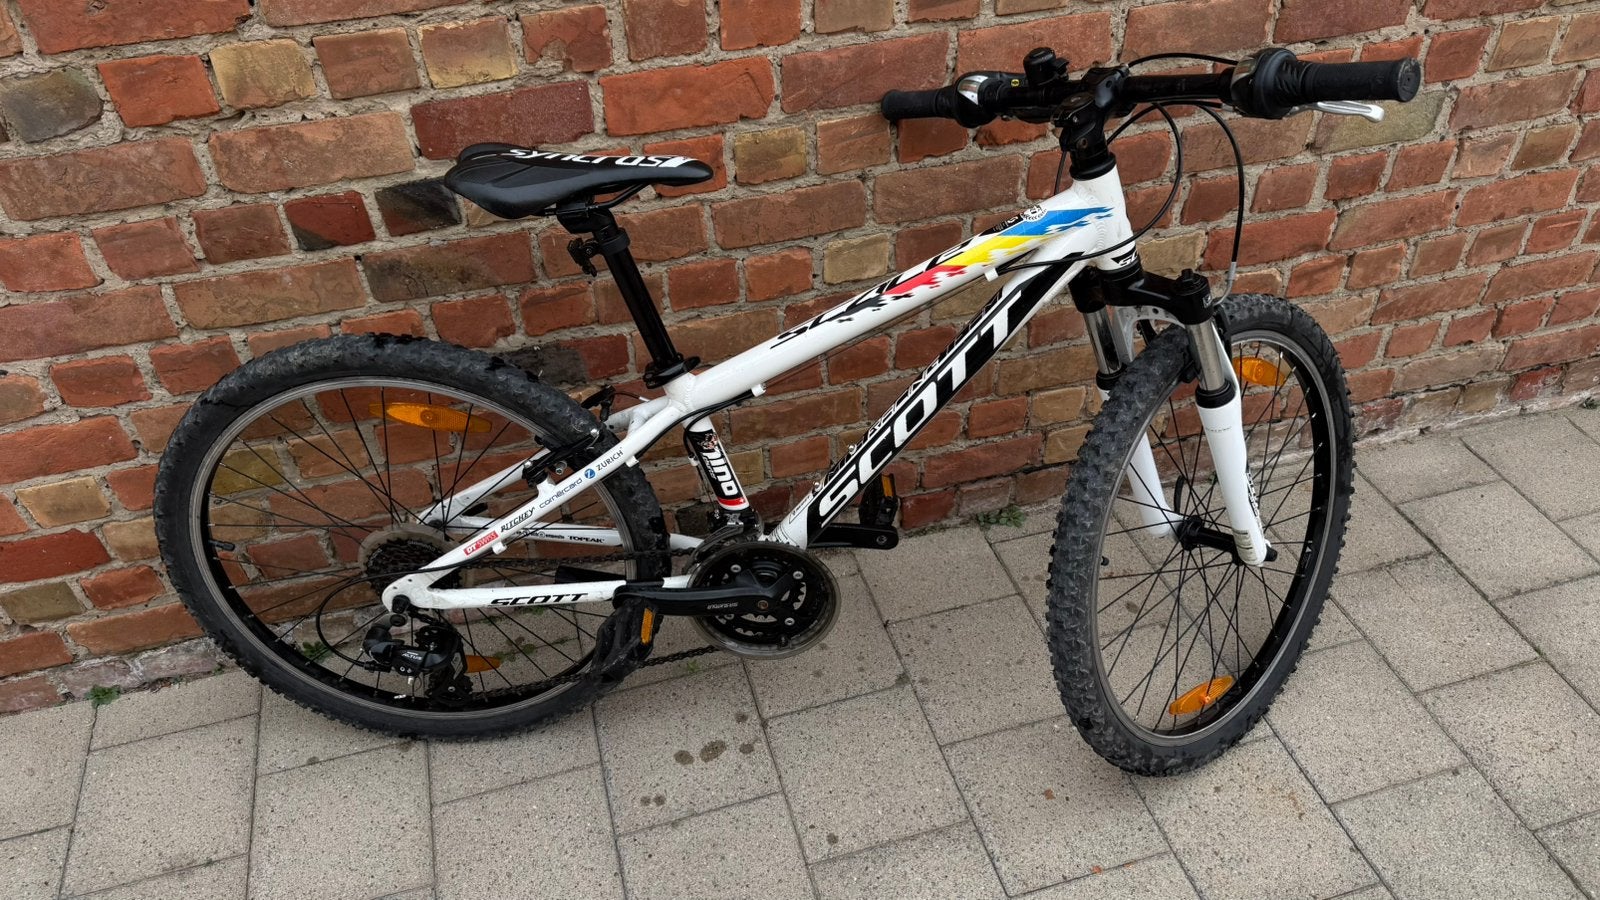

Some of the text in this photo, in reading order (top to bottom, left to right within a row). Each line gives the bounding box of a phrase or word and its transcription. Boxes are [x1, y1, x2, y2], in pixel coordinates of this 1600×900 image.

[819, 289, 1022, 528] SCOTT
[596, 450, 624, 471] ZURICH
[500, 507, 535, 533] RITCHEY
[570, 535, 602, 544] TOPEAK
[488, 593, 588, 607] SCOTT
